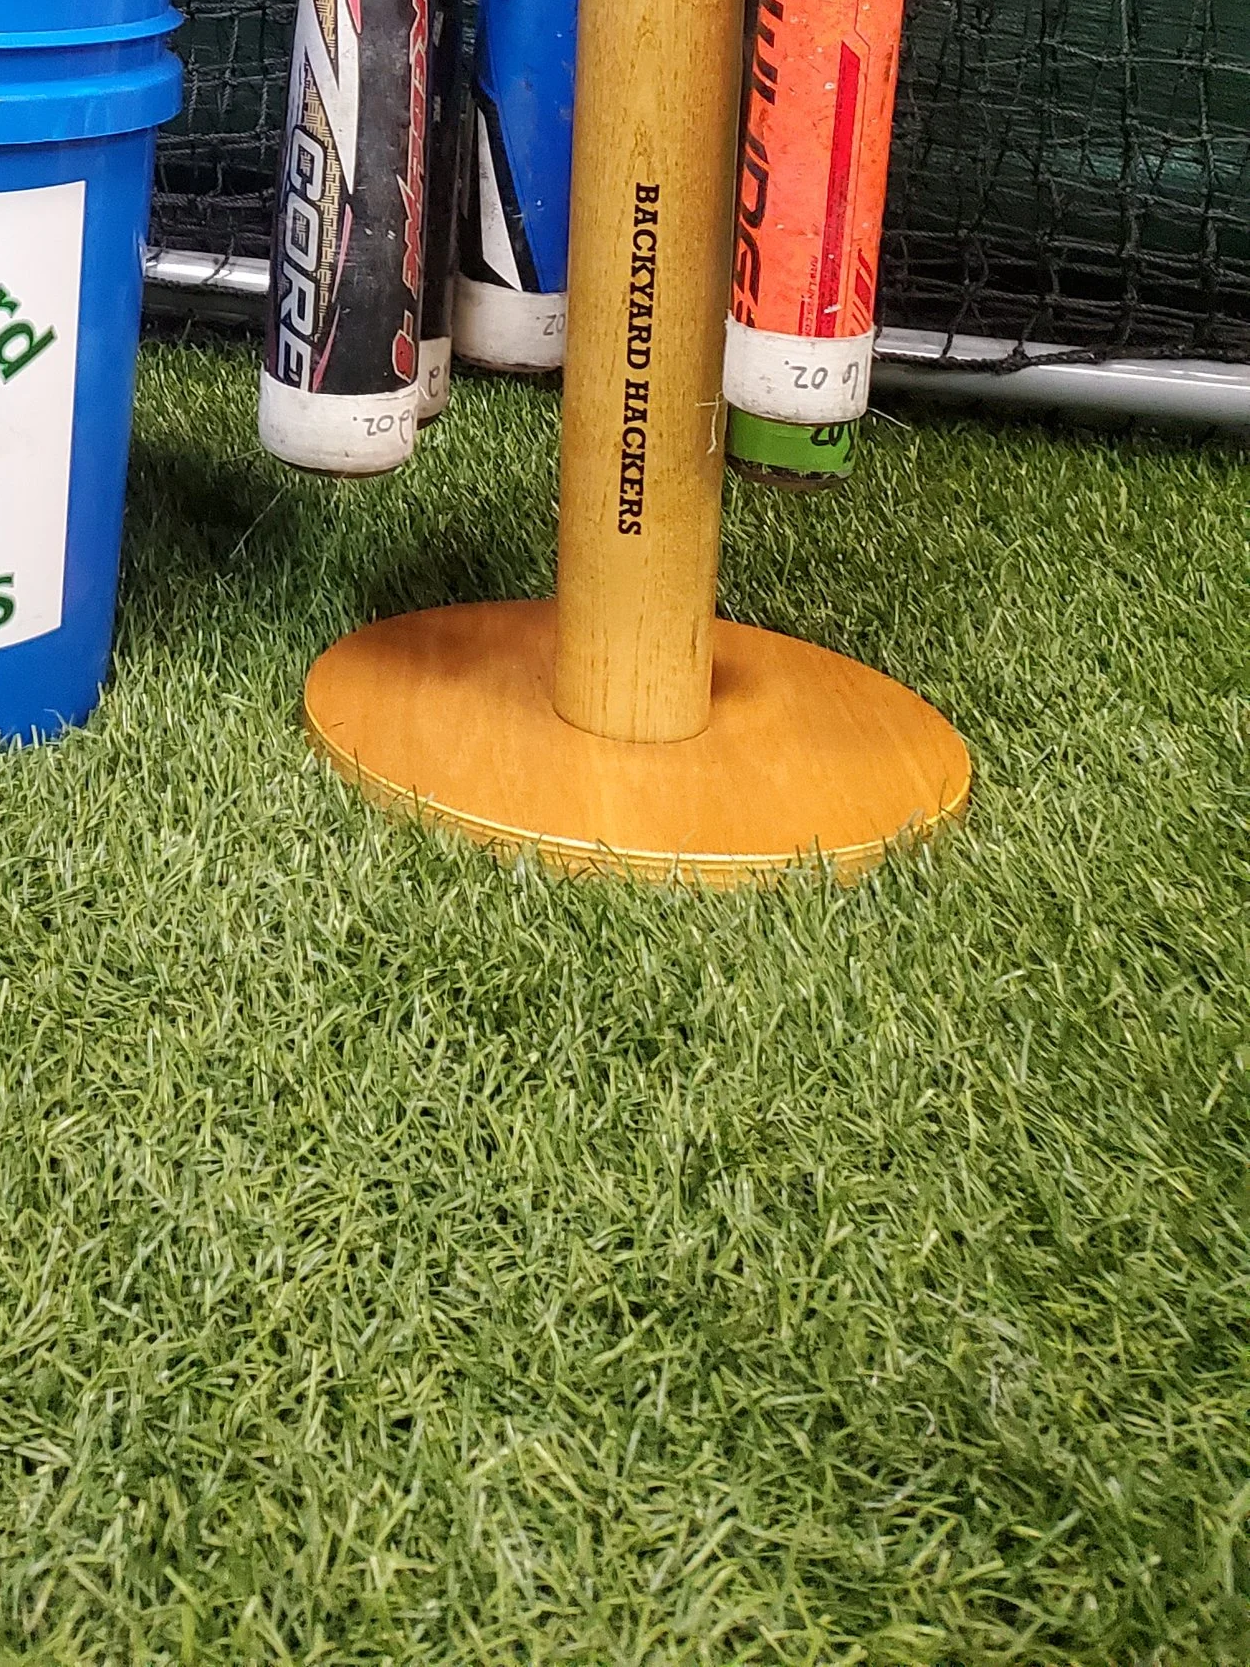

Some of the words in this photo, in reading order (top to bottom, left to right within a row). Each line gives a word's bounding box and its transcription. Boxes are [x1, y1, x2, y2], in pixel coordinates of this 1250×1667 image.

[276, 129, 327, 392] CORE
[626, 183, 660, 370] BACKYARD
[618, 379, 651, 536] HACKERS
